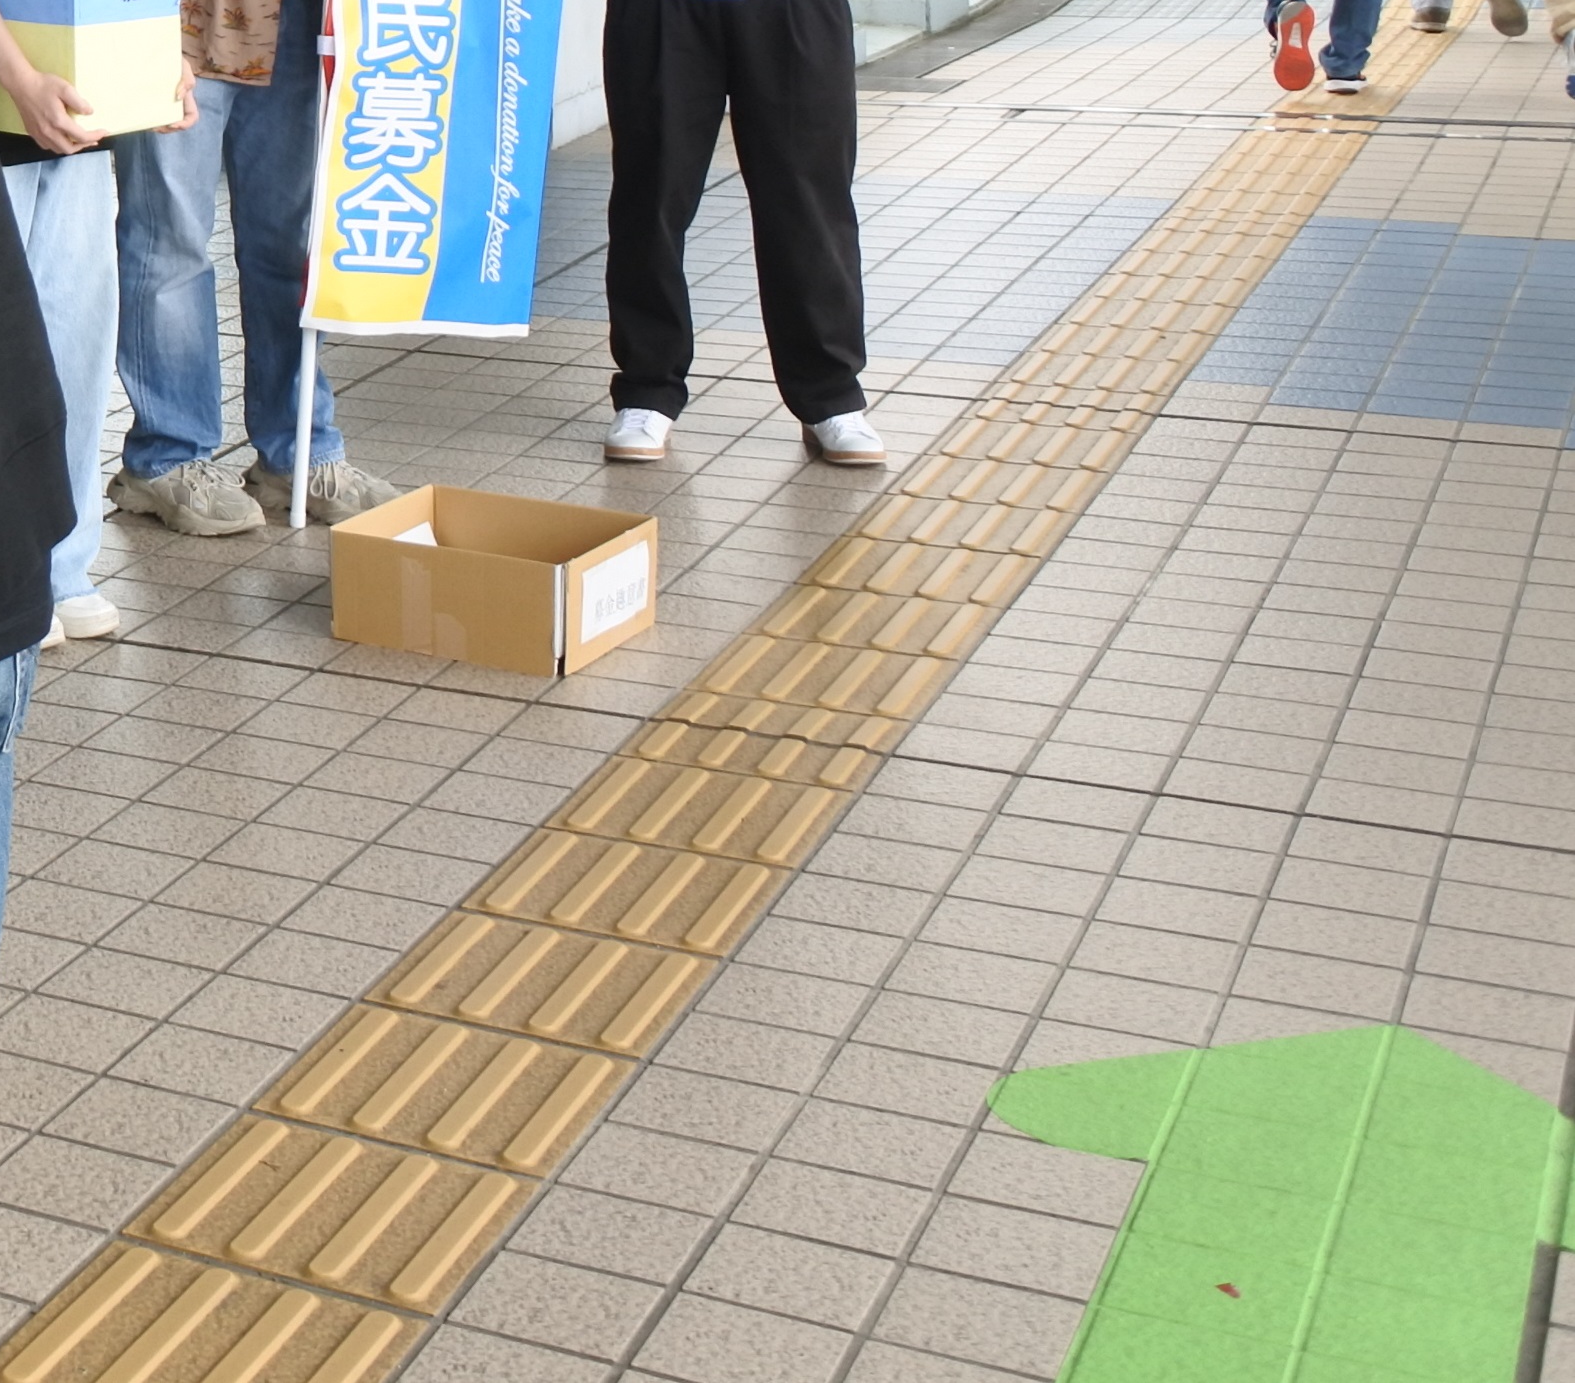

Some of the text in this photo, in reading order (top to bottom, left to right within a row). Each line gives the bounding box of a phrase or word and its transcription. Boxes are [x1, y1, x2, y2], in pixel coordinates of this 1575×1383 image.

[505, 37, 521, 57] a
[499, 61, 529, 176] donation
[490, 164, 521, 215] for
[485, 210, 511, 283] peace
